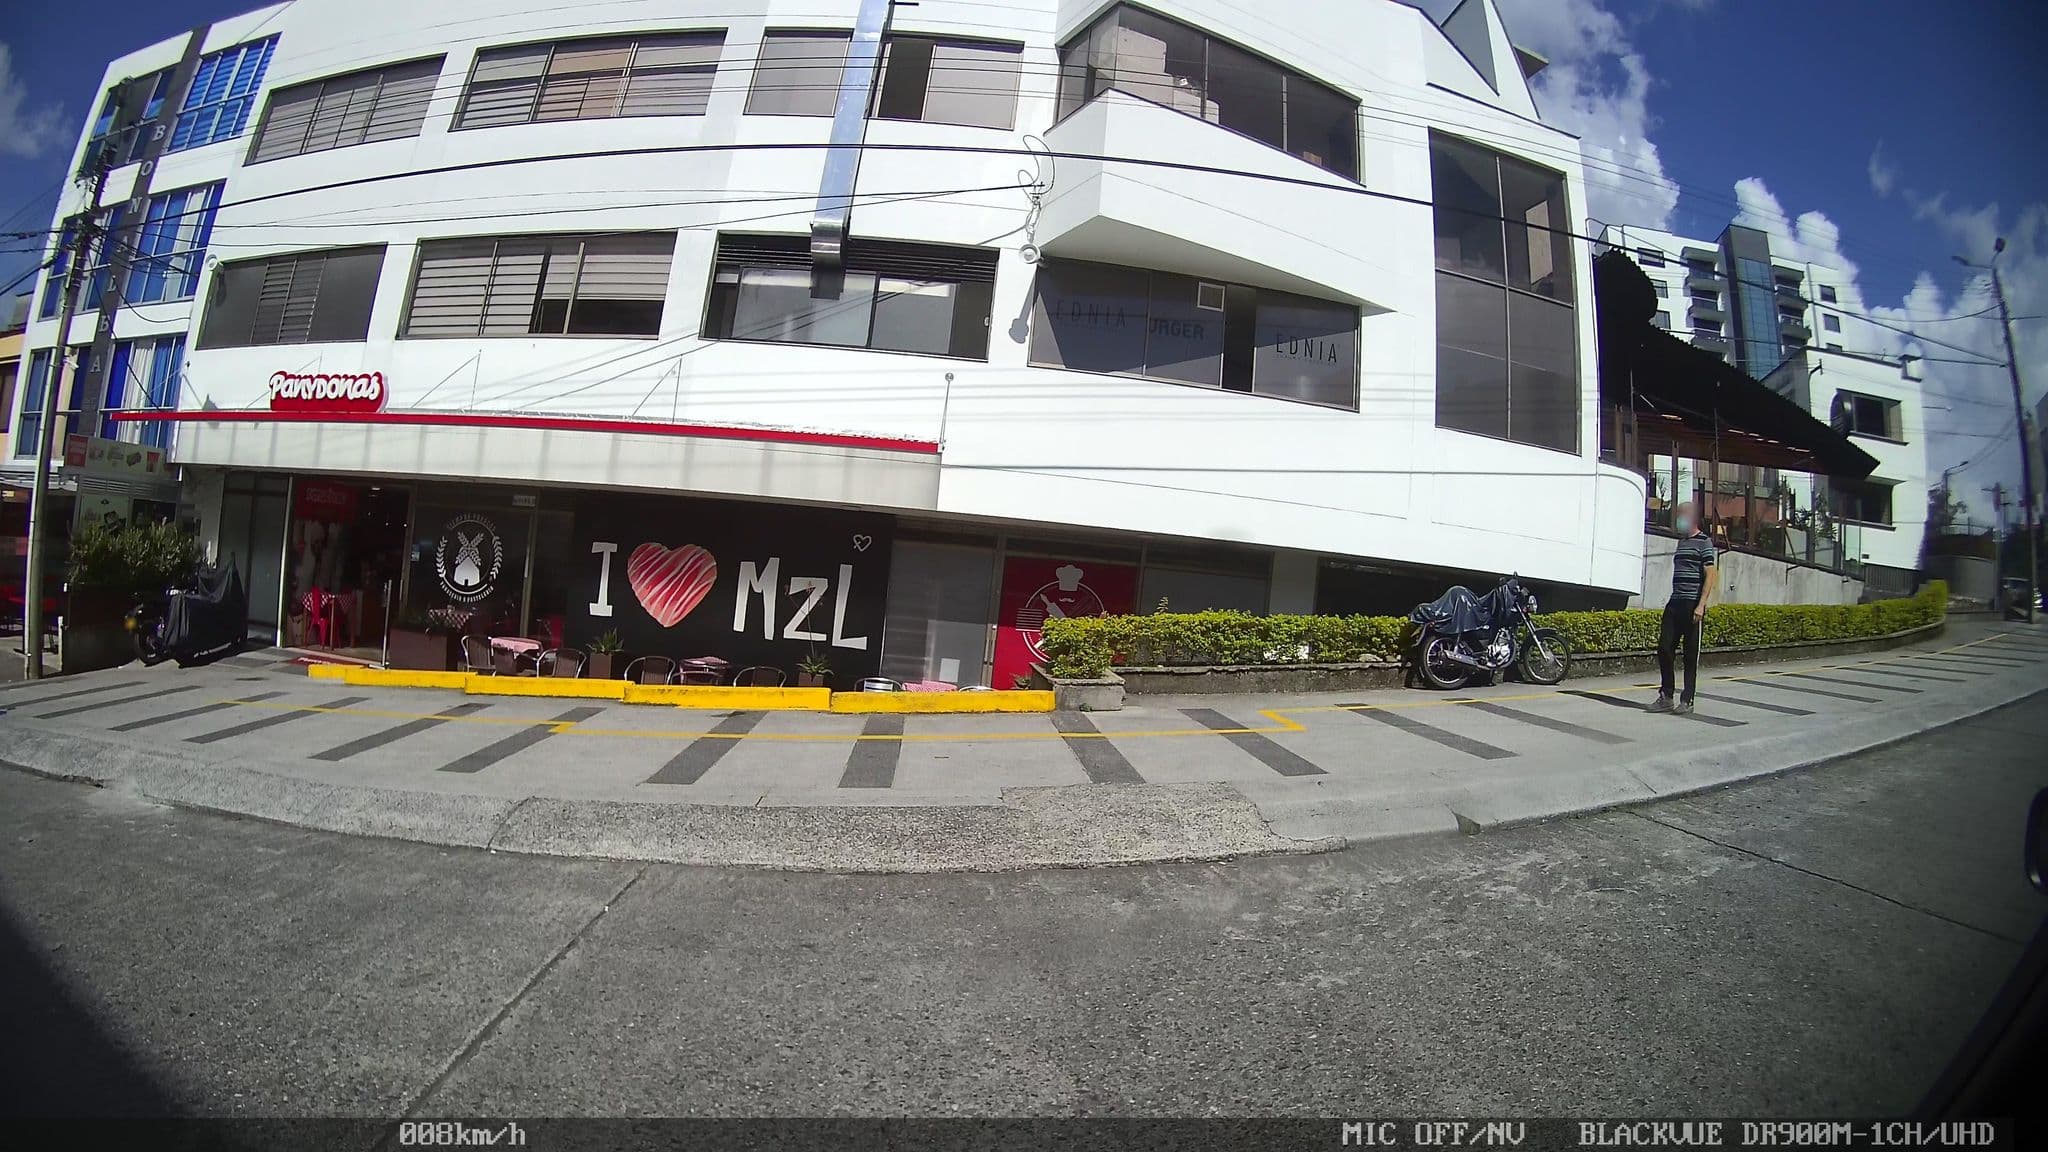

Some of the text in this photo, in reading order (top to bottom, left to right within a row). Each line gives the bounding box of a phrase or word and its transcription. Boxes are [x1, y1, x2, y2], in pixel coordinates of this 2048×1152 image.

[1056, 299, 1126, 328] EDNIA
[1276, 330, 1337, 363] EDNIA
[589, 541, 618, 617] I
